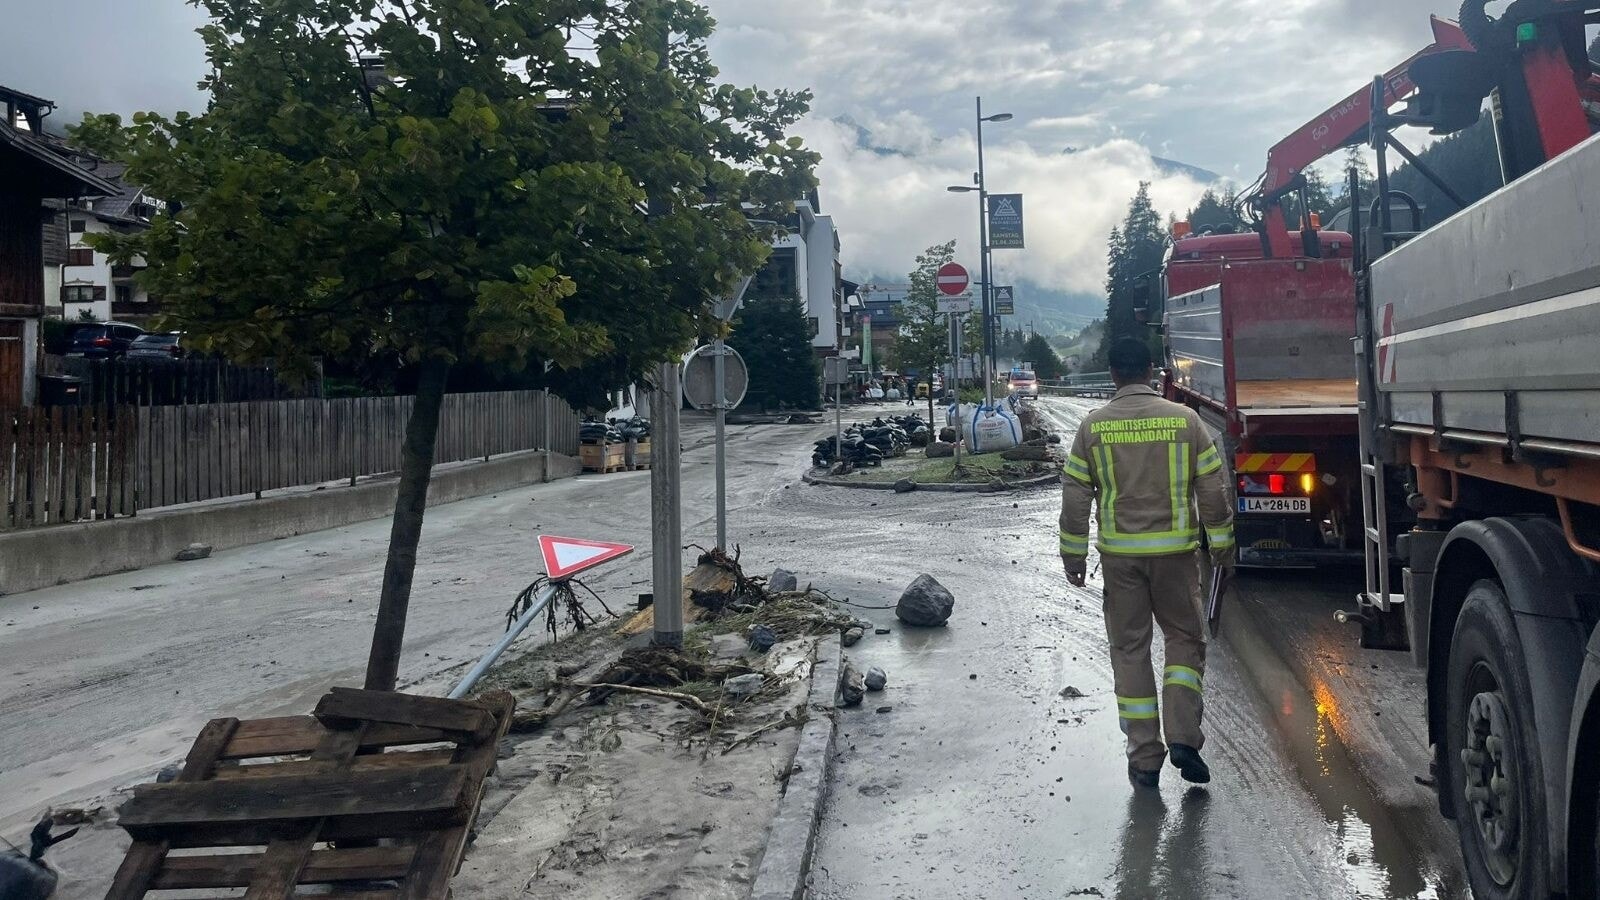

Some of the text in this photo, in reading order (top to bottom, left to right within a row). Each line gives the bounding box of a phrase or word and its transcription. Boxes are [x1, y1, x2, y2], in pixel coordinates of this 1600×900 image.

[1090, 417, 1188, 433] ABSCHNITTSFEUERWEHR
[1100, 429, 1177, 444] KOMMANDANT
[1248, 500, 1307, 511] LA 284 DB
